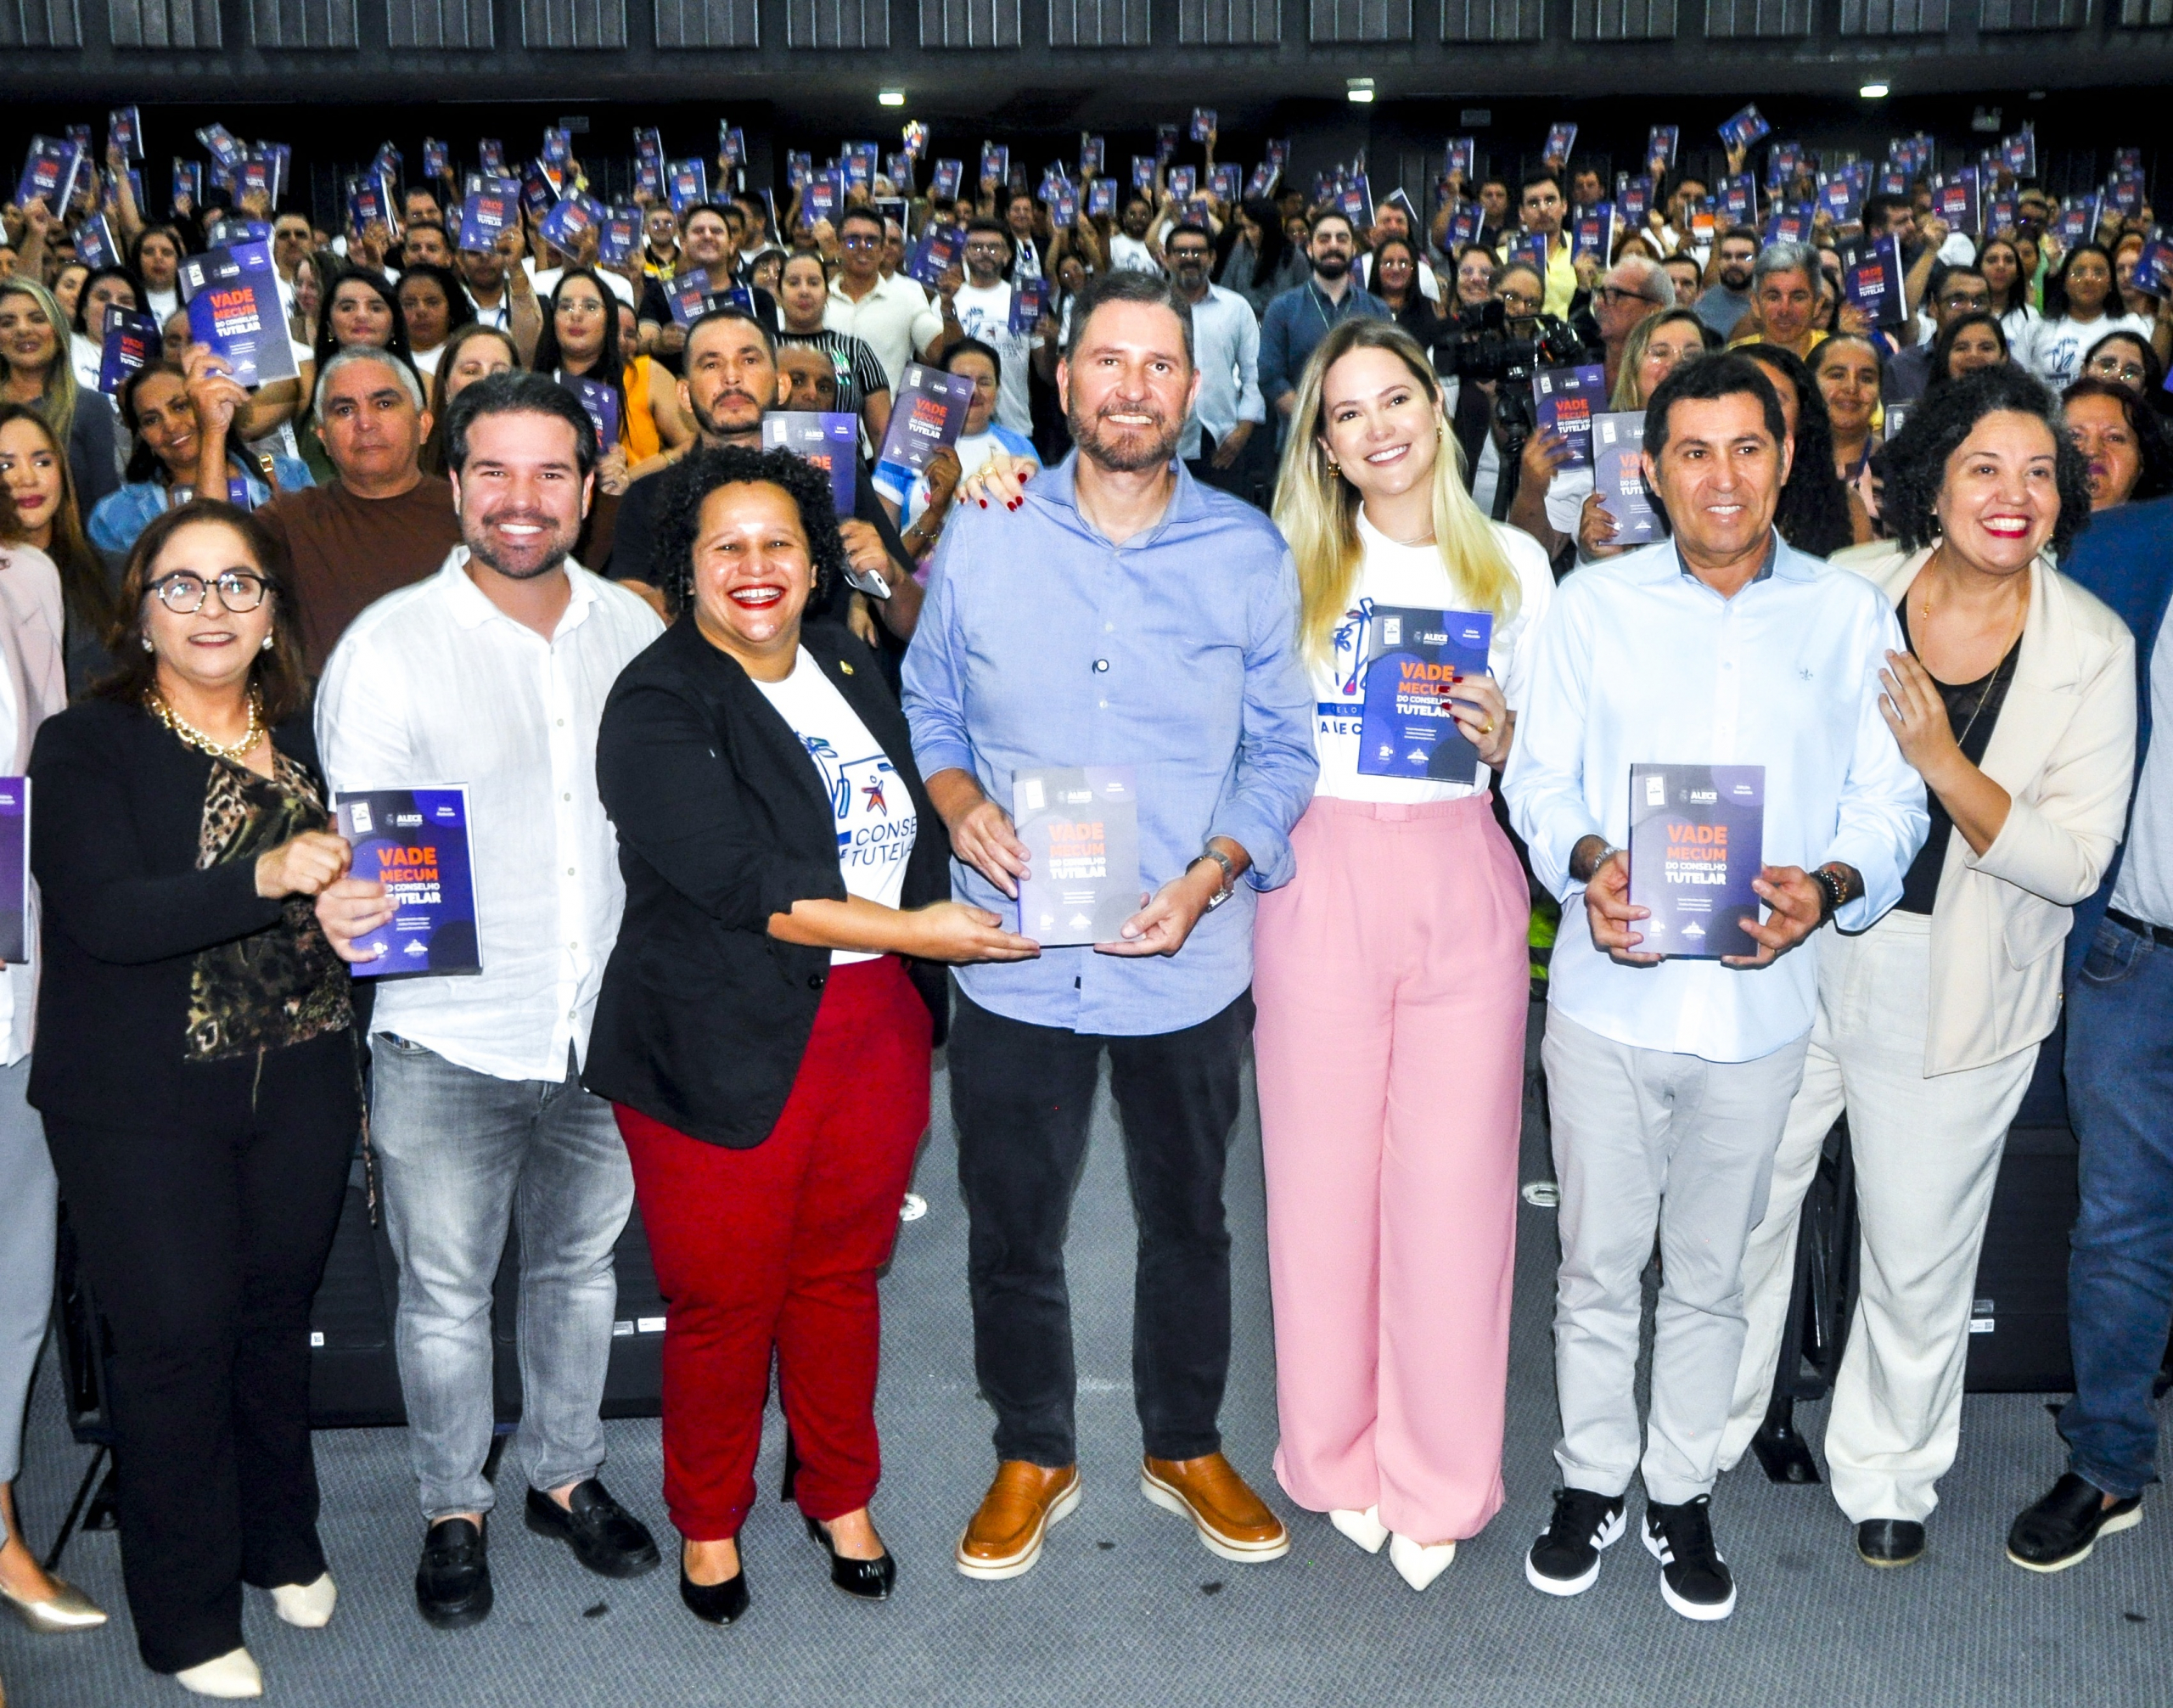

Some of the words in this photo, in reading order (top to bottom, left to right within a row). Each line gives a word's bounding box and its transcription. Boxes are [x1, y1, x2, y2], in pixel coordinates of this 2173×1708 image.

[211, 288, 255, 308] VADE
[213, 304, 257, 320] MECUM
[215, 319, 226, 328] DO
[226, 315, 259, 327] CONSELHO
[216, 323, 261, 337] TUTELAR
[915, 397, 948, 418] VADE
[1556, 398, 1588, 410] VADE
[912, 409, 946, 426] MECUM
[1557, 410, 1590, 420] MECUM
[908, 423, 941, 439] TUTELAR
[918, 419, 943, 432] CONSELHO
[1423, 633, 1448, 643] ALECE
[1401, 662, 1455, 682] VADE
[1398, 682, 1440, 695] MECU
[1410, 695, 1452, 705] CONSELHO
[1395, 704, 1451, 718] TUTELAR
[396, 814, 423, 823] ALECE
[856, 816, 917, 846] CONSE
[1048, 822, 1105, 841] VADE
[1667, 824, 1727, 845] VADE
[377, 846, 437, 866] VADE
[1049, 843, 1105, 857] MECUM
[1667, 847, 1727, 862] MECUM
[1049, 858, 1062, 867] DO
[1063, 857, 1106, 867] CONSELHO
[1665, 862, 1678, 870] DO
[1680, 862, 1727, 871] CONSELHO
[379, 868, 439, 883] MECUM
[1049, 867, 1107, 879] TUTELAR
[1665, 873, 1727, 885] TUTELAR
[395, 882, 441, 892] CONSELHO
[385, 891, 441, 904] TELAR
